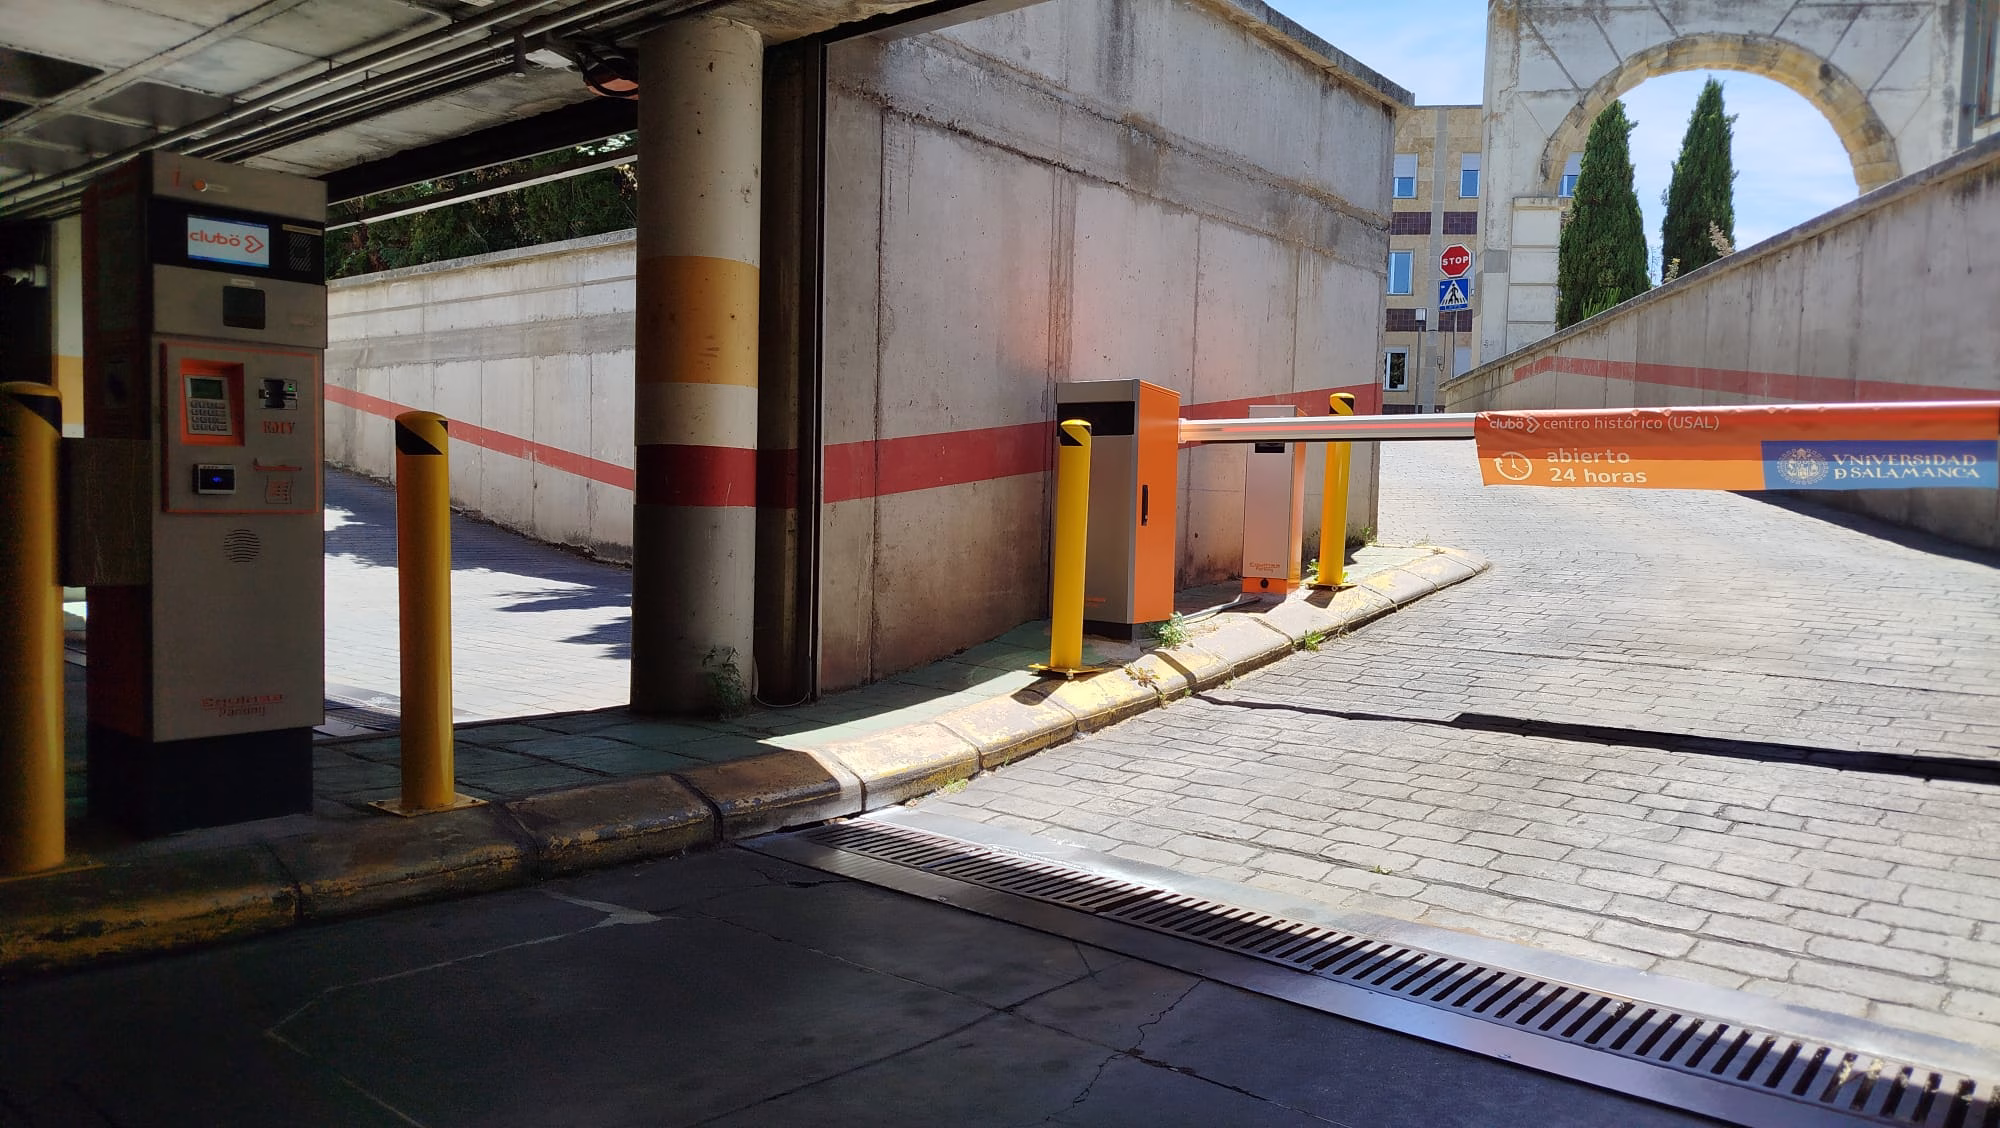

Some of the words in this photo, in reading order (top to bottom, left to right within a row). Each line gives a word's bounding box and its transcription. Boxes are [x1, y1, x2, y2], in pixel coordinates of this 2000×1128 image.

[190, 230, 241, 246] clubö
[1442, 256, 1468, 266] STOP
[1489, 417, 1524, 430] clubö
[1543, 416, 1590, 429] centro
[1594, 415, 1663, 429] histórico
[1667, 415, 1720, 431] (USAL)
[1546, 448, 1630, 464] abierto
[1550, 467, 1577, 482] 24
[1584, 468, 1647, 483] horas
[1850, 467, 1980, 479] SALAMANCA
